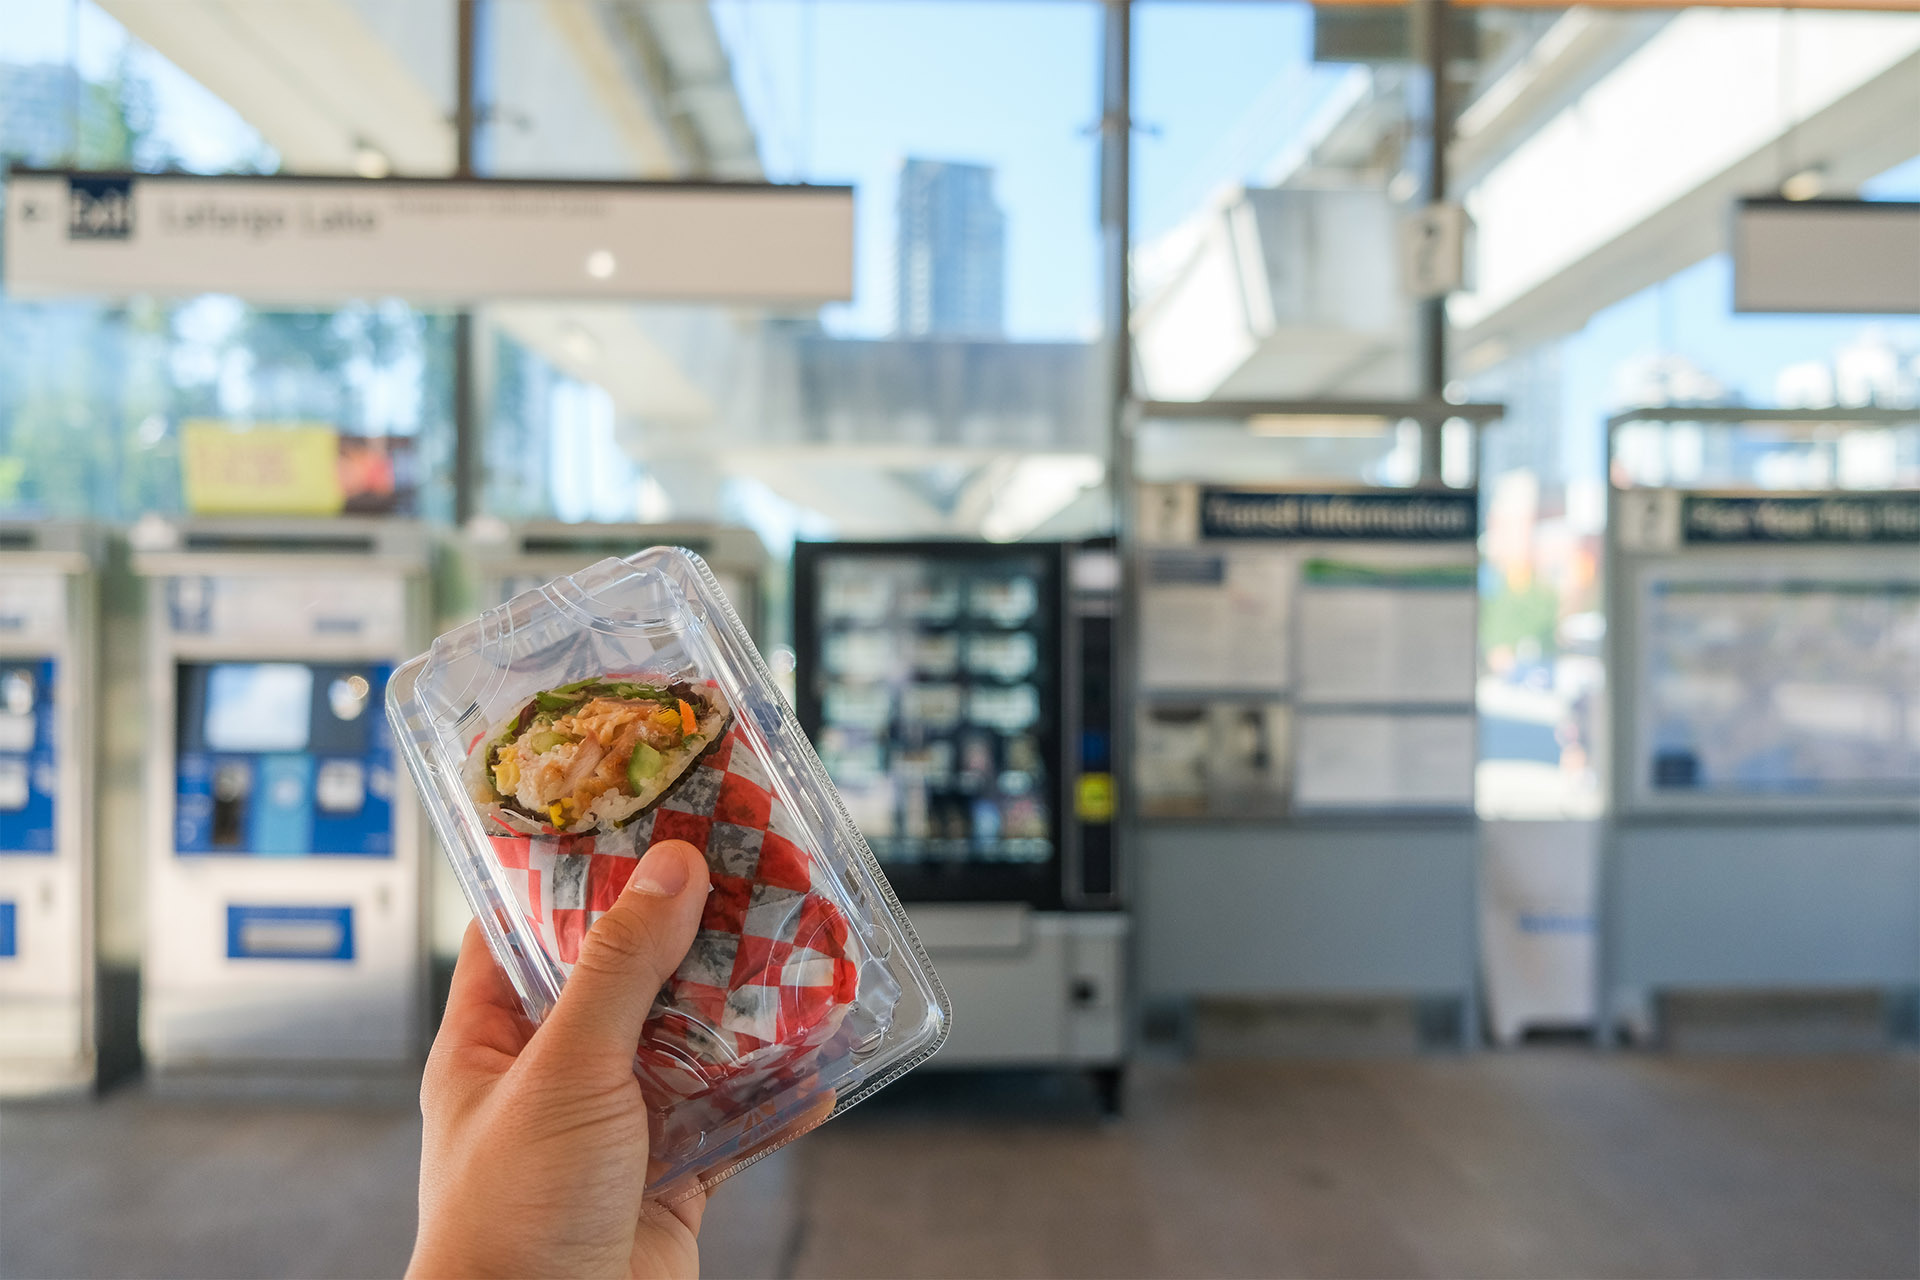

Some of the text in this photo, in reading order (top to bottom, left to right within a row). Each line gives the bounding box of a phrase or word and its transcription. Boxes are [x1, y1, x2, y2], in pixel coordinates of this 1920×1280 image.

[304, 203, 377, 233] Lake
[1206, 496, 1298, 529] Transit
[1302, 496, 1468, 529] Information
